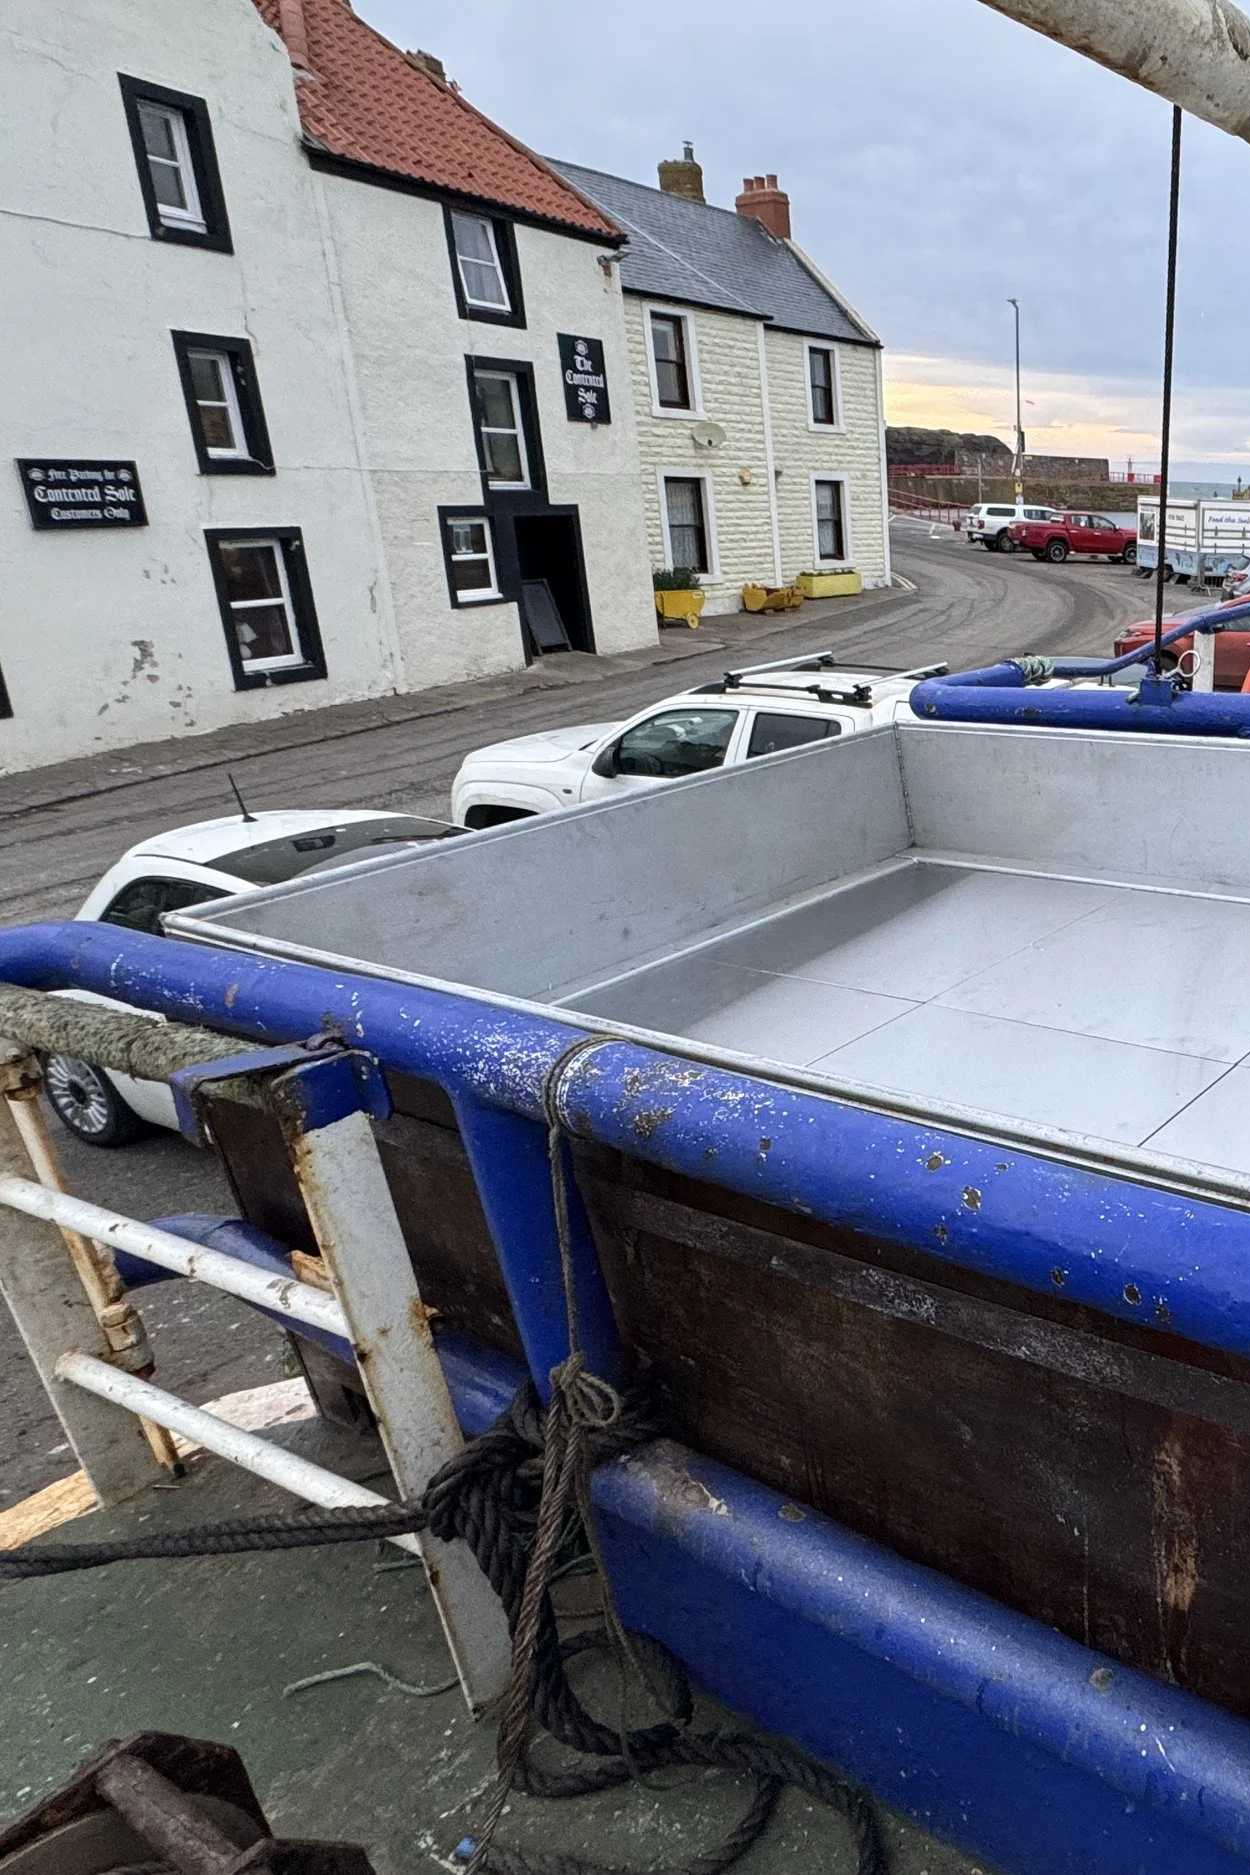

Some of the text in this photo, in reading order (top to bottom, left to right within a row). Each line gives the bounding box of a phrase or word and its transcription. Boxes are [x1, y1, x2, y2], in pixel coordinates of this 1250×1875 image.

[573, 355, 593, 372] The
[565, 369, 605, 388] Contented
[577, 387, 598, 404] Sole
[33, 485, 137, 503] Contented Sole
[103, 506, 131, 521] Only
